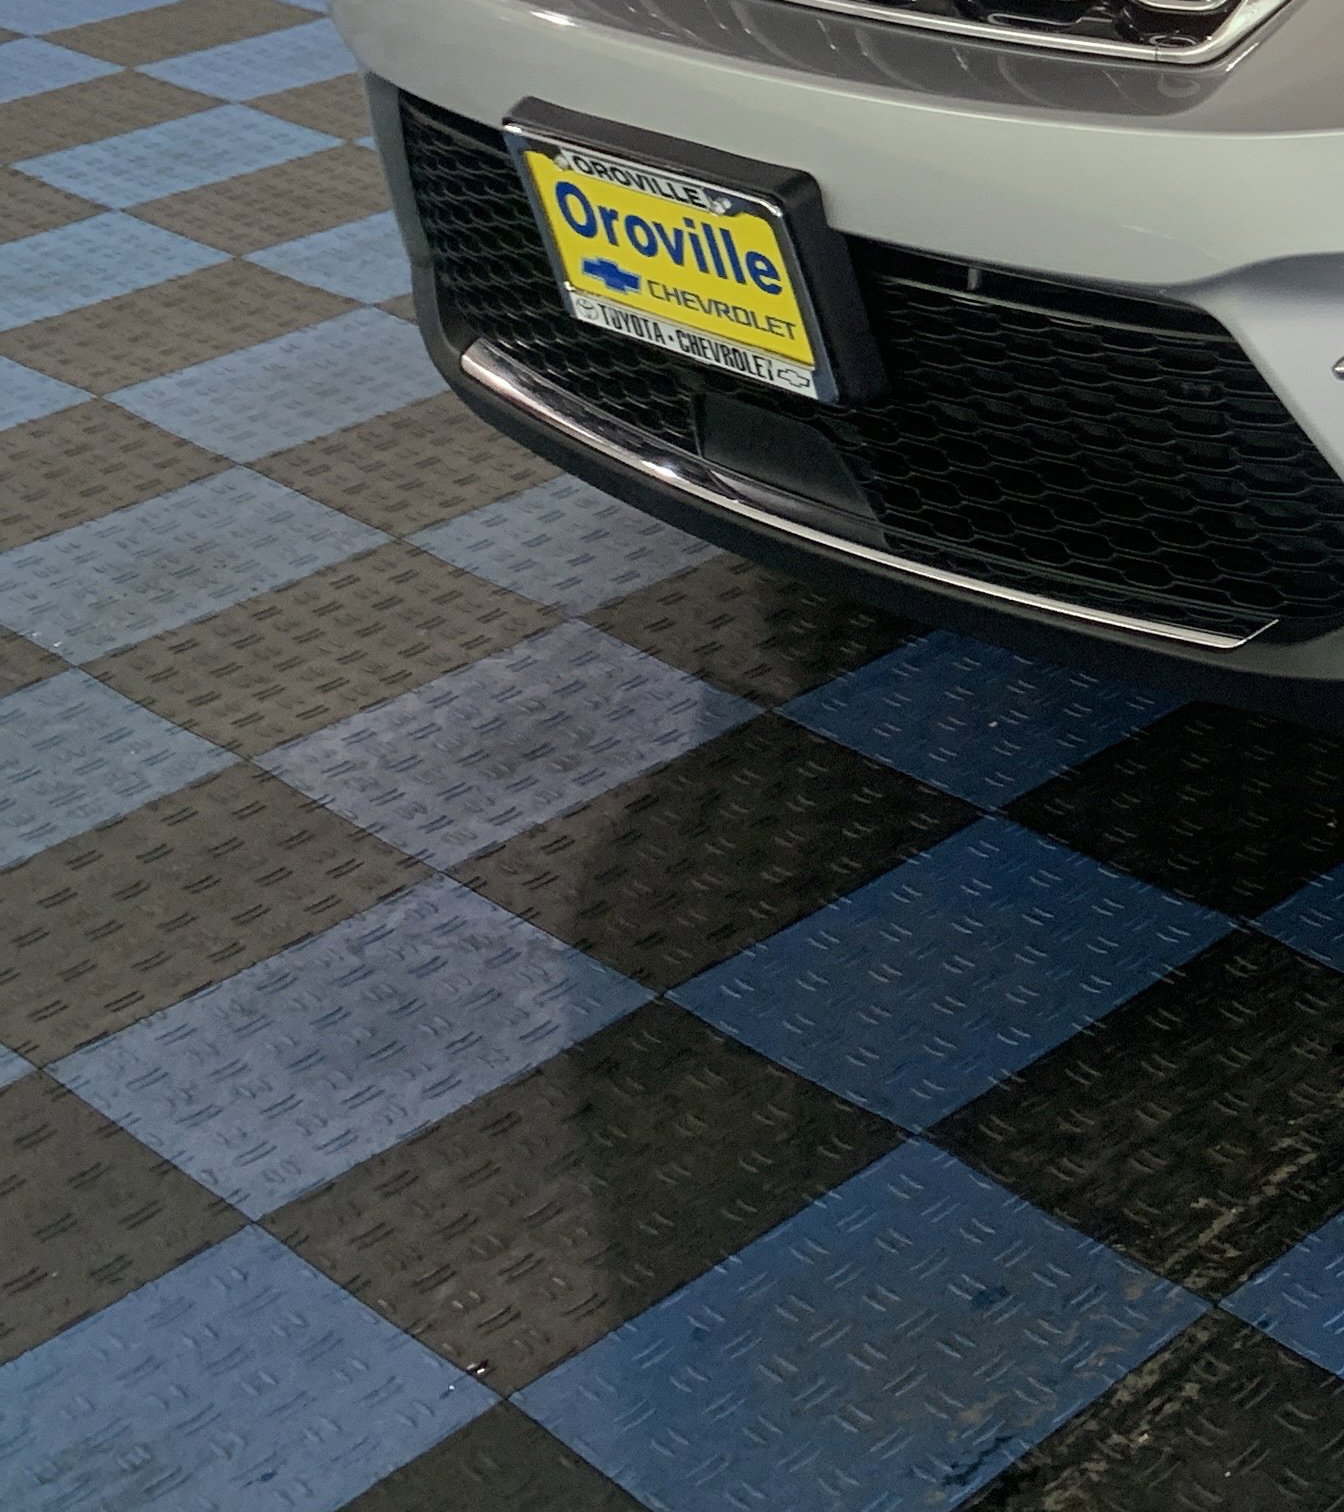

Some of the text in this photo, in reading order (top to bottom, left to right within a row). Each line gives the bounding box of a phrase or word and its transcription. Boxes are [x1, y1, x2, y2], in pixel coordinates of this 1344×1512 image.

[573, 154, 708, 210] OROVILLE
[555, 181, 784, 296] Oroville
[599, 303, 775, 382] TOYOTA CHEVROLET
[647, 279, 797, 342] CHEVROLET
